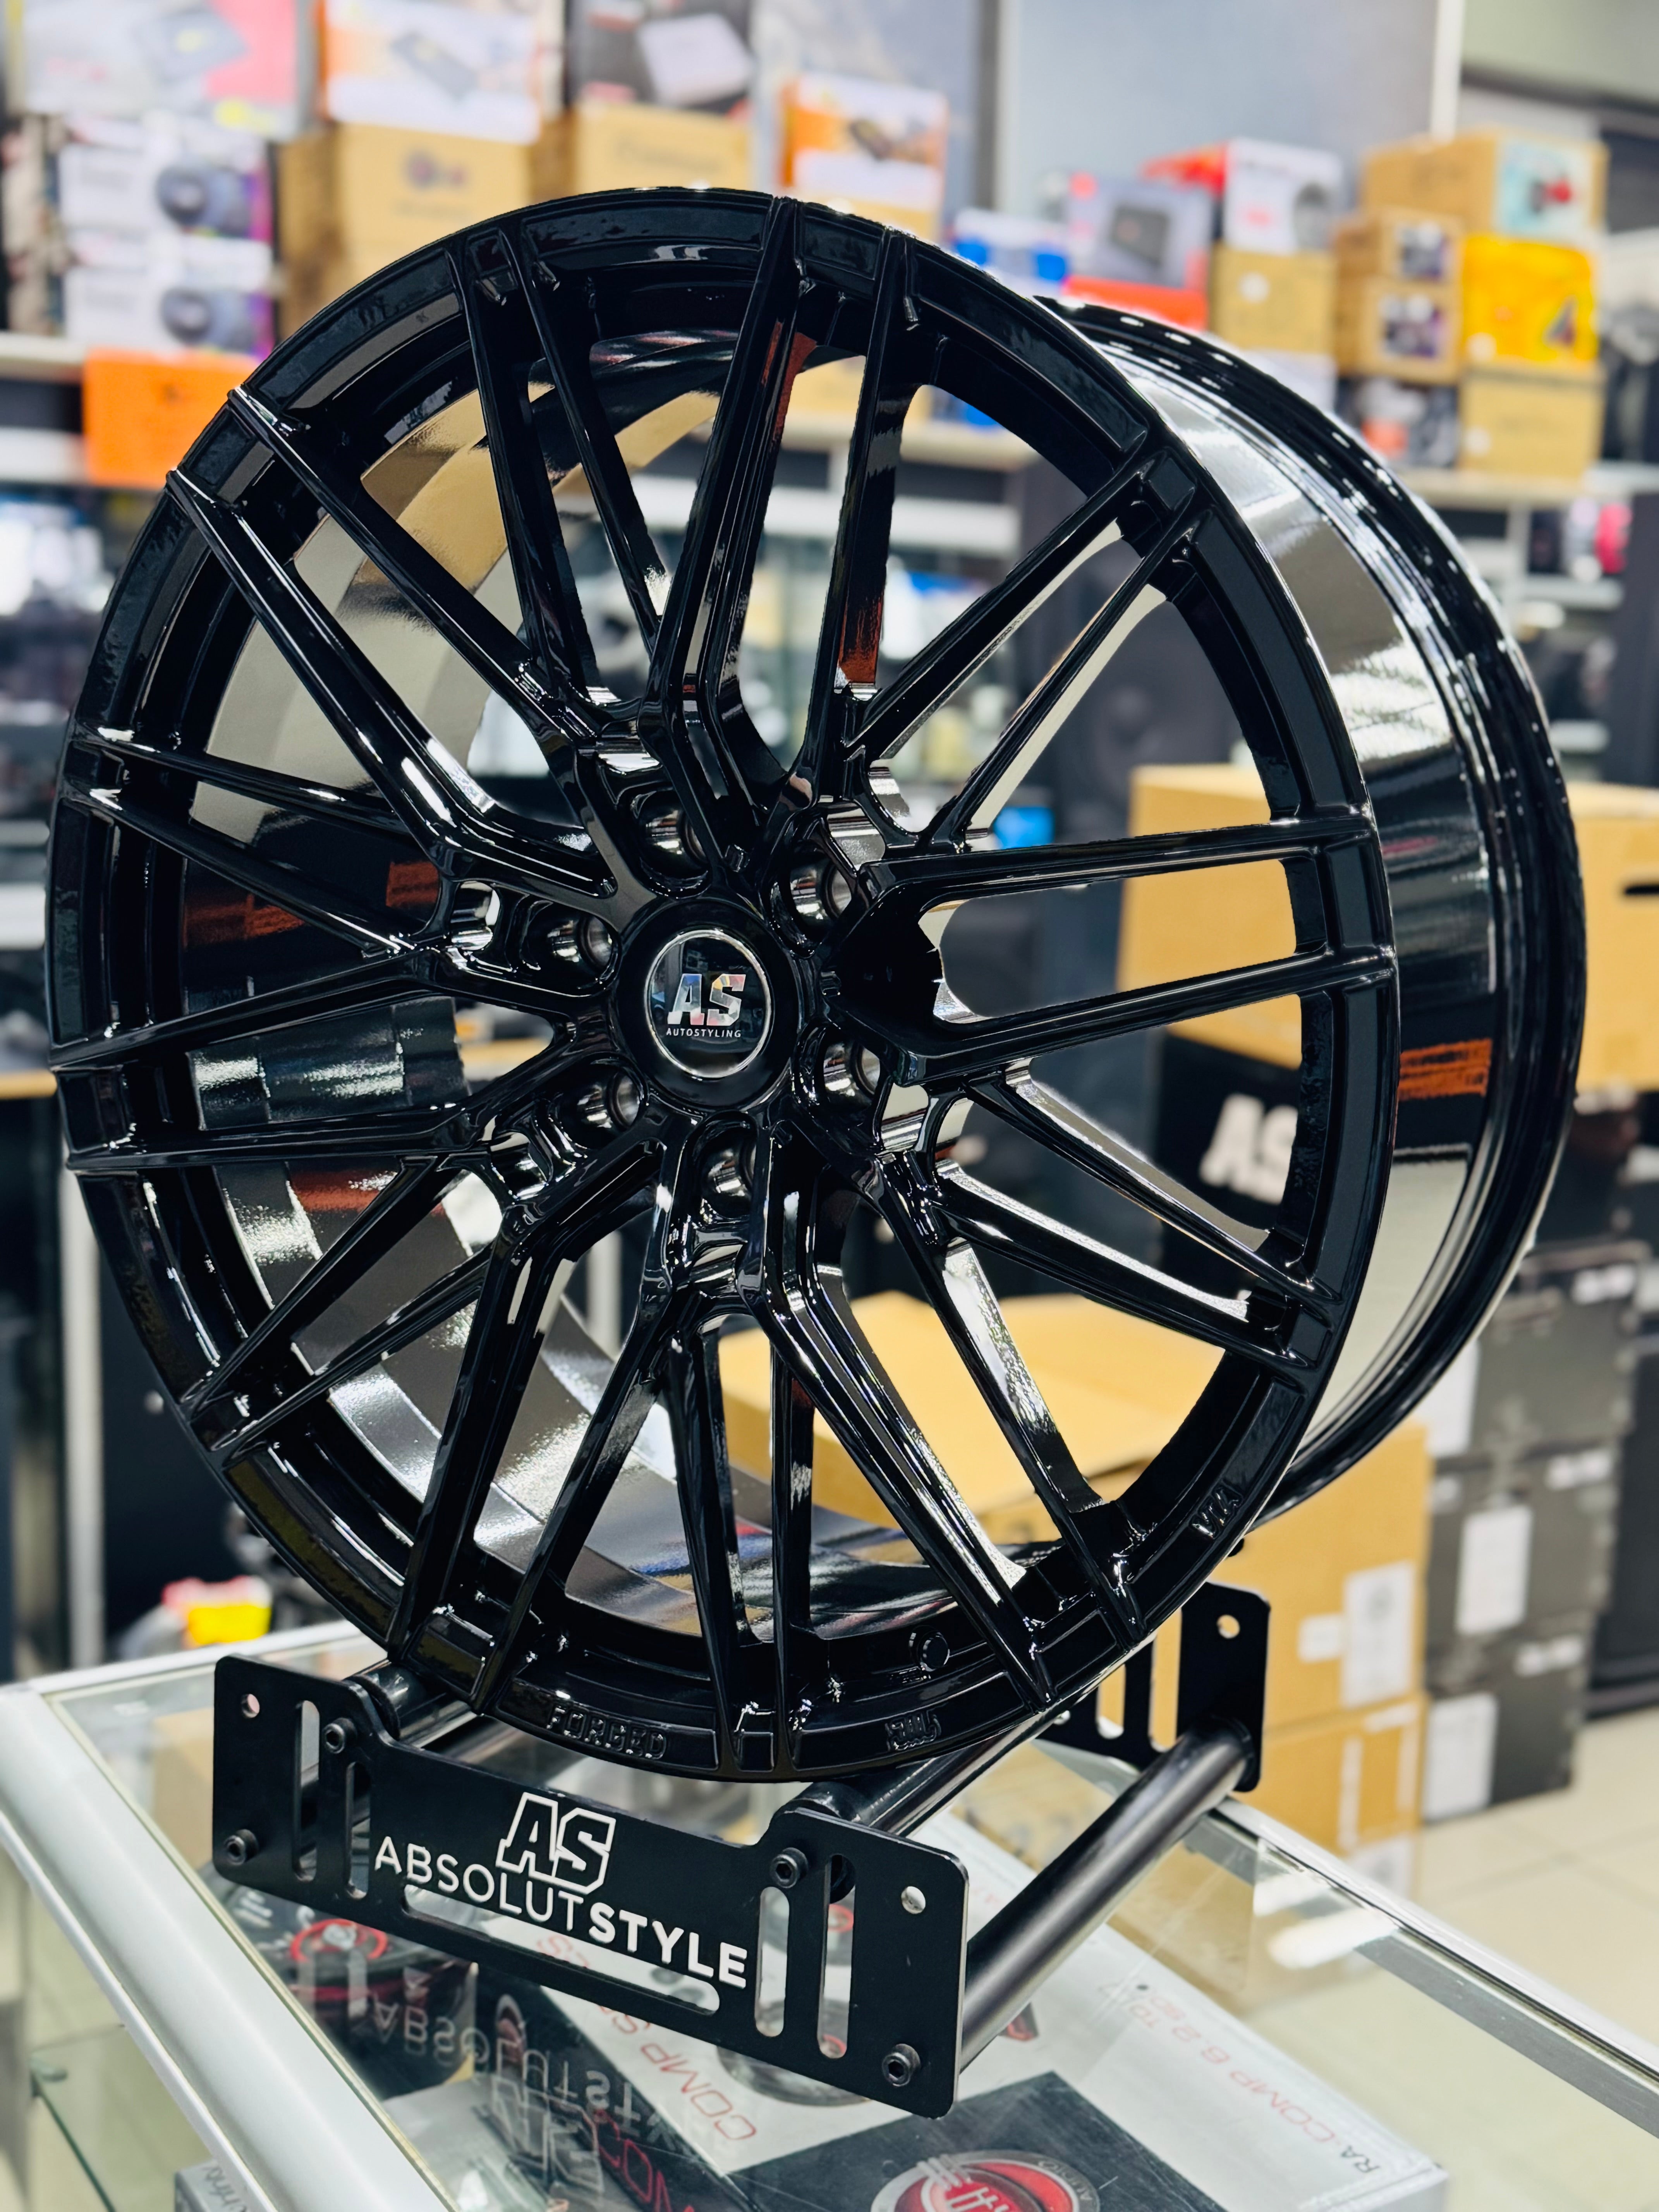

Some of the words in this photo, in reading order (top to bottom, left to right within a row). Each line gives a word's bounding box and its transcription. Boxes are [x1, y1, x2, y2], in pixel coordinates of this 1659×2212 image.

[666, 1027, 742, 1038] AUTOSTYLING
[667, 973, 746, 1026] AS
[496, 1791, 617, 1895] AS
[640, 2043, 757, 2141] COMP
